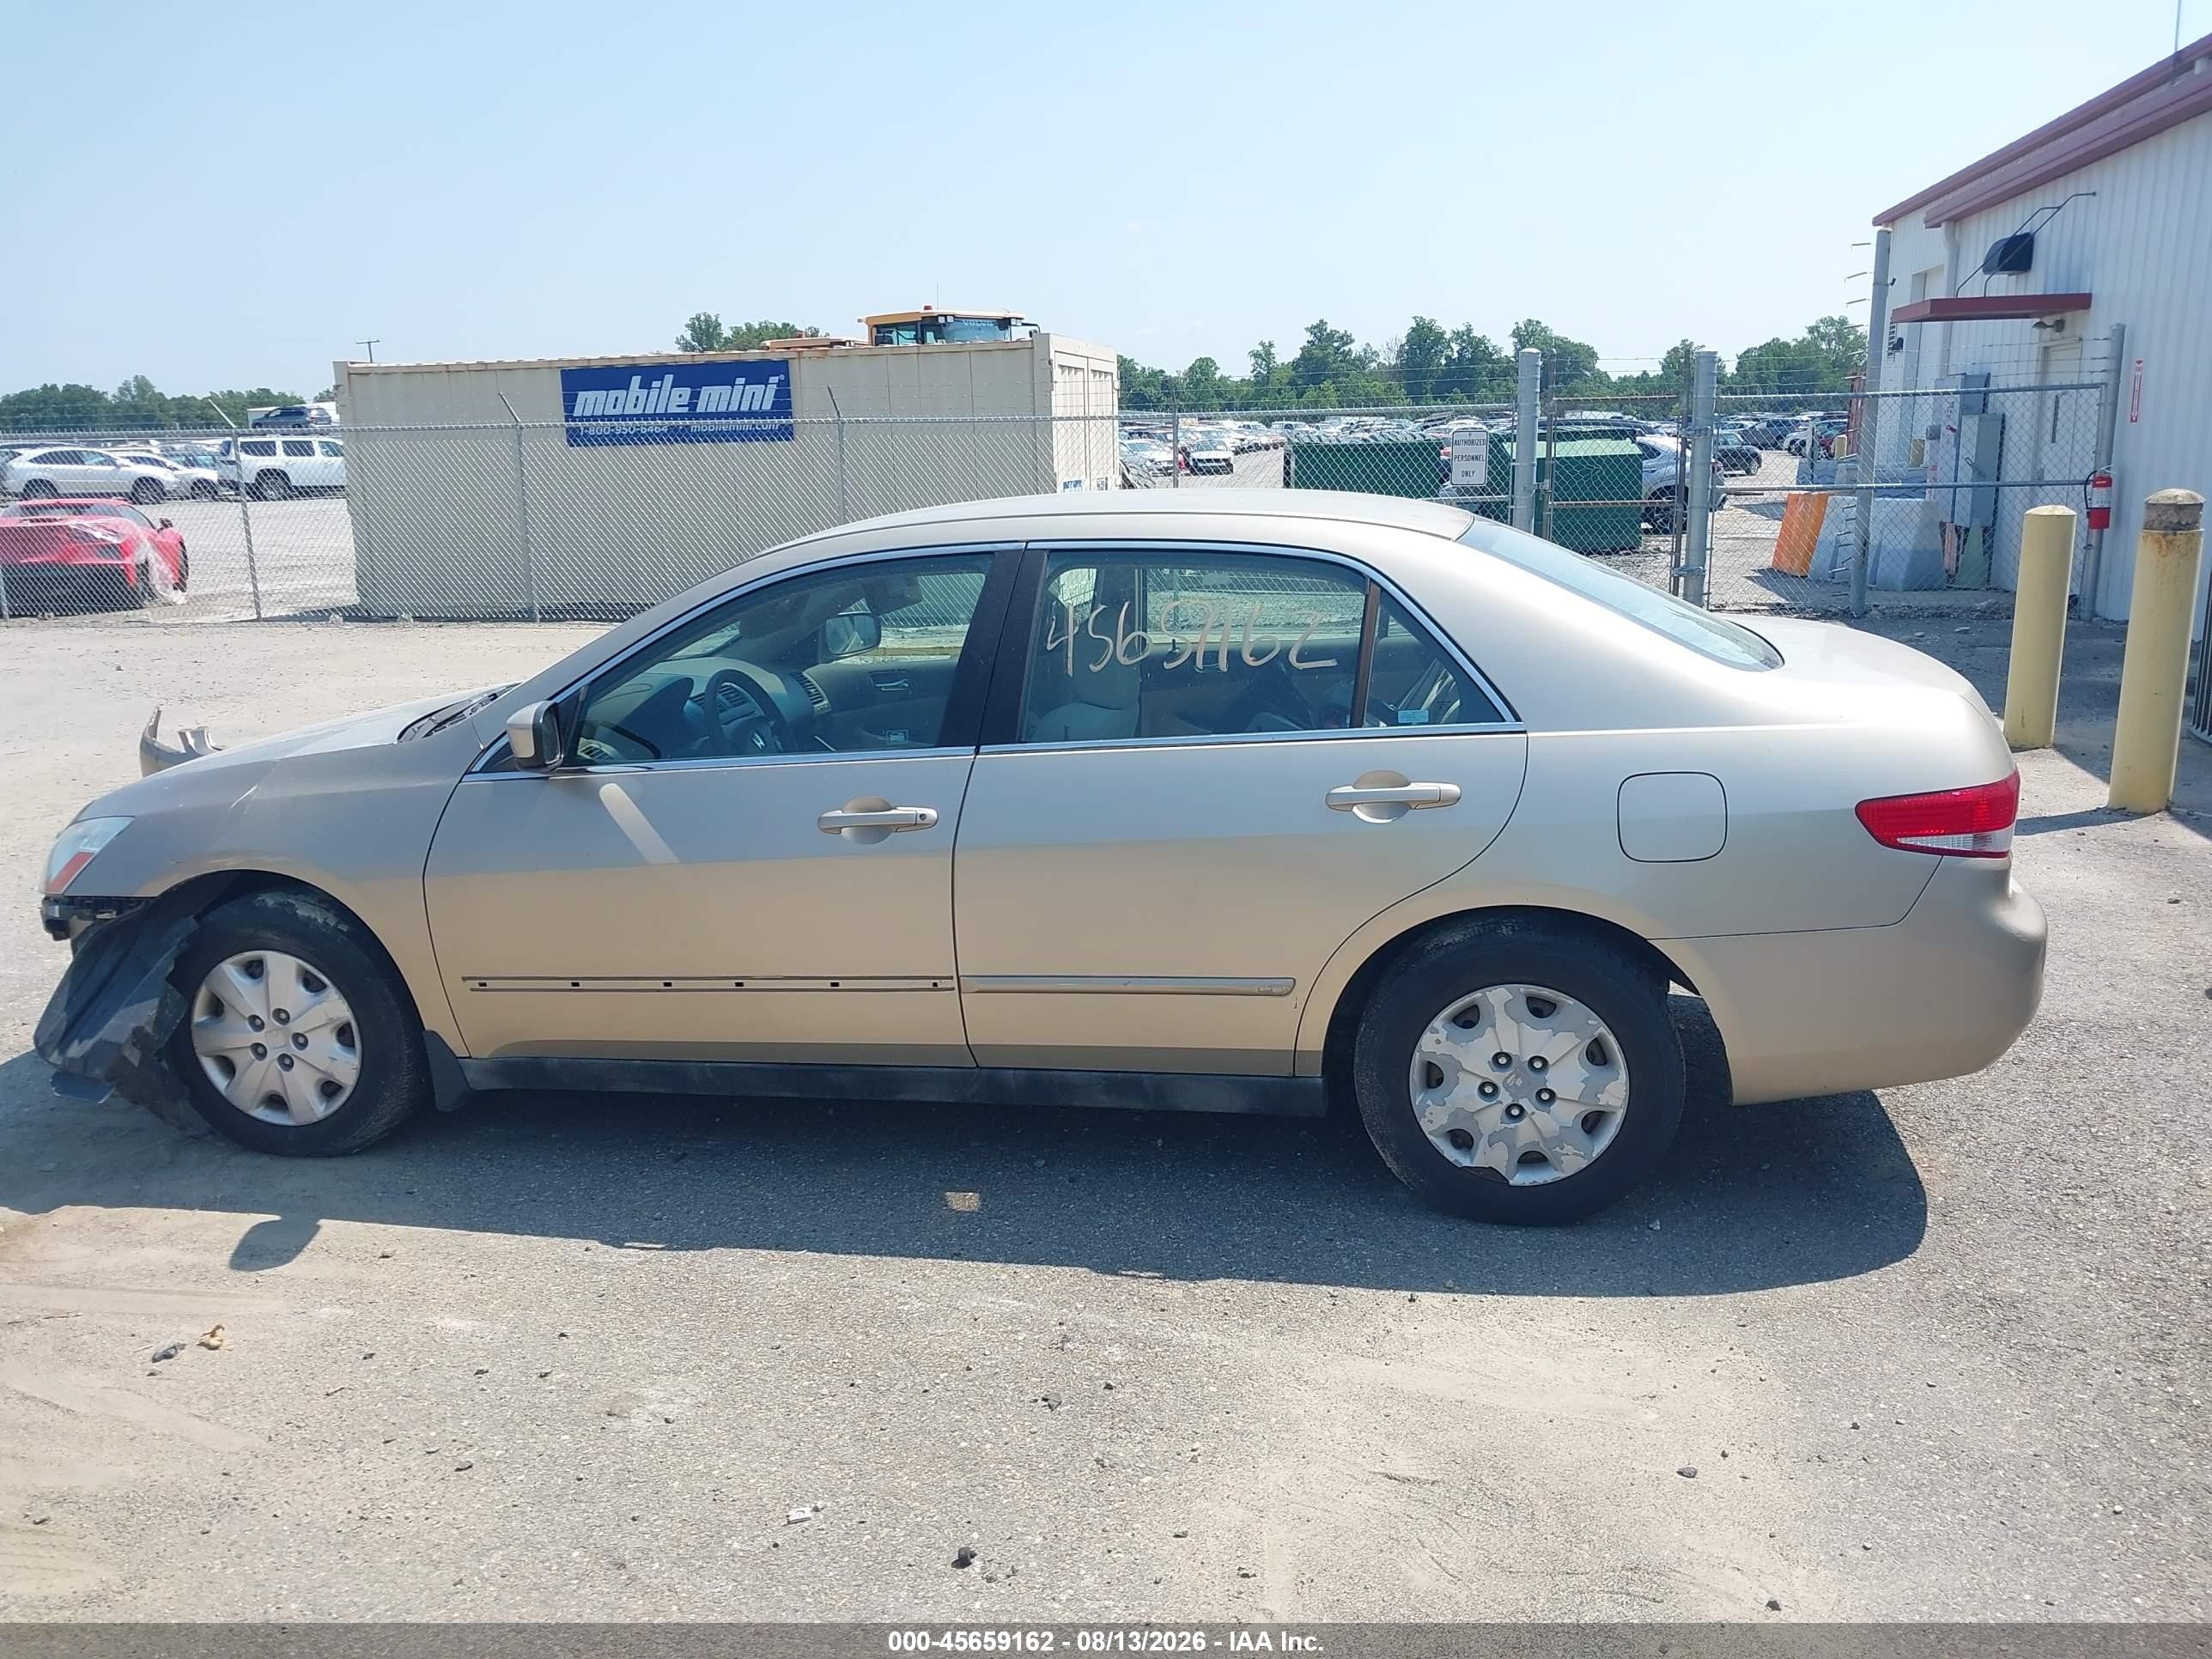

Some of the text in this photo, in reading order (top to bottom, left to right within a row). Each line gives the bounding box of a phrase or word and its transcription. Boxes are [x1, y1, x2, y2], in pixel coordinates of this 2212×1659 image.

[573, 374, 780, 416] mobile mini
[1454, 438, 1486, 447] AUTHORIZED
[1454, 453, 1486, 462] PERSONNEL
